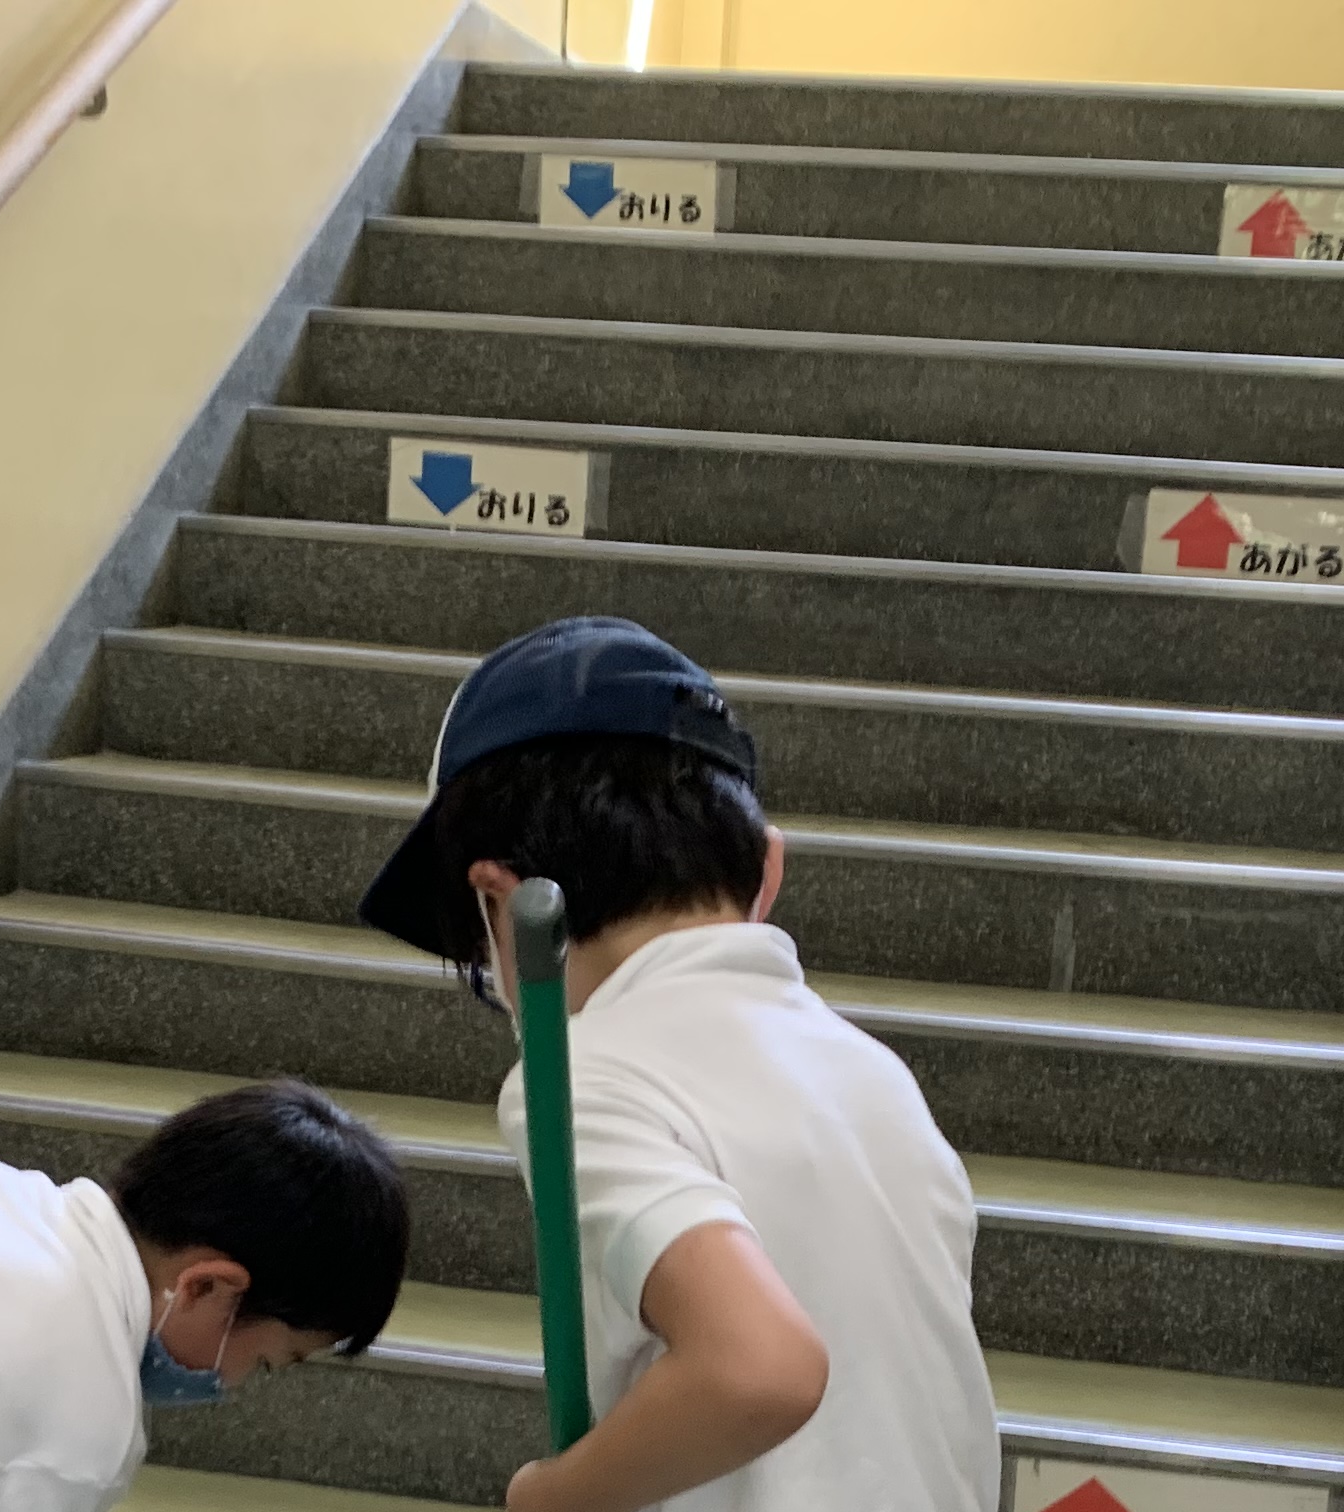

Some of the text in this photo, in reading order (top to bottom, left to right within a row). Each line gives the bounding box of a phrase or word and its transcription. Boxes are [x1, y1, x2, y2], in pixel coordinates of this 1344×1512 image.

[619, 192, 701, 223] おりる
[478, 488, 570, 526] おりる
[1240, 542, 1343, 577] あがる
